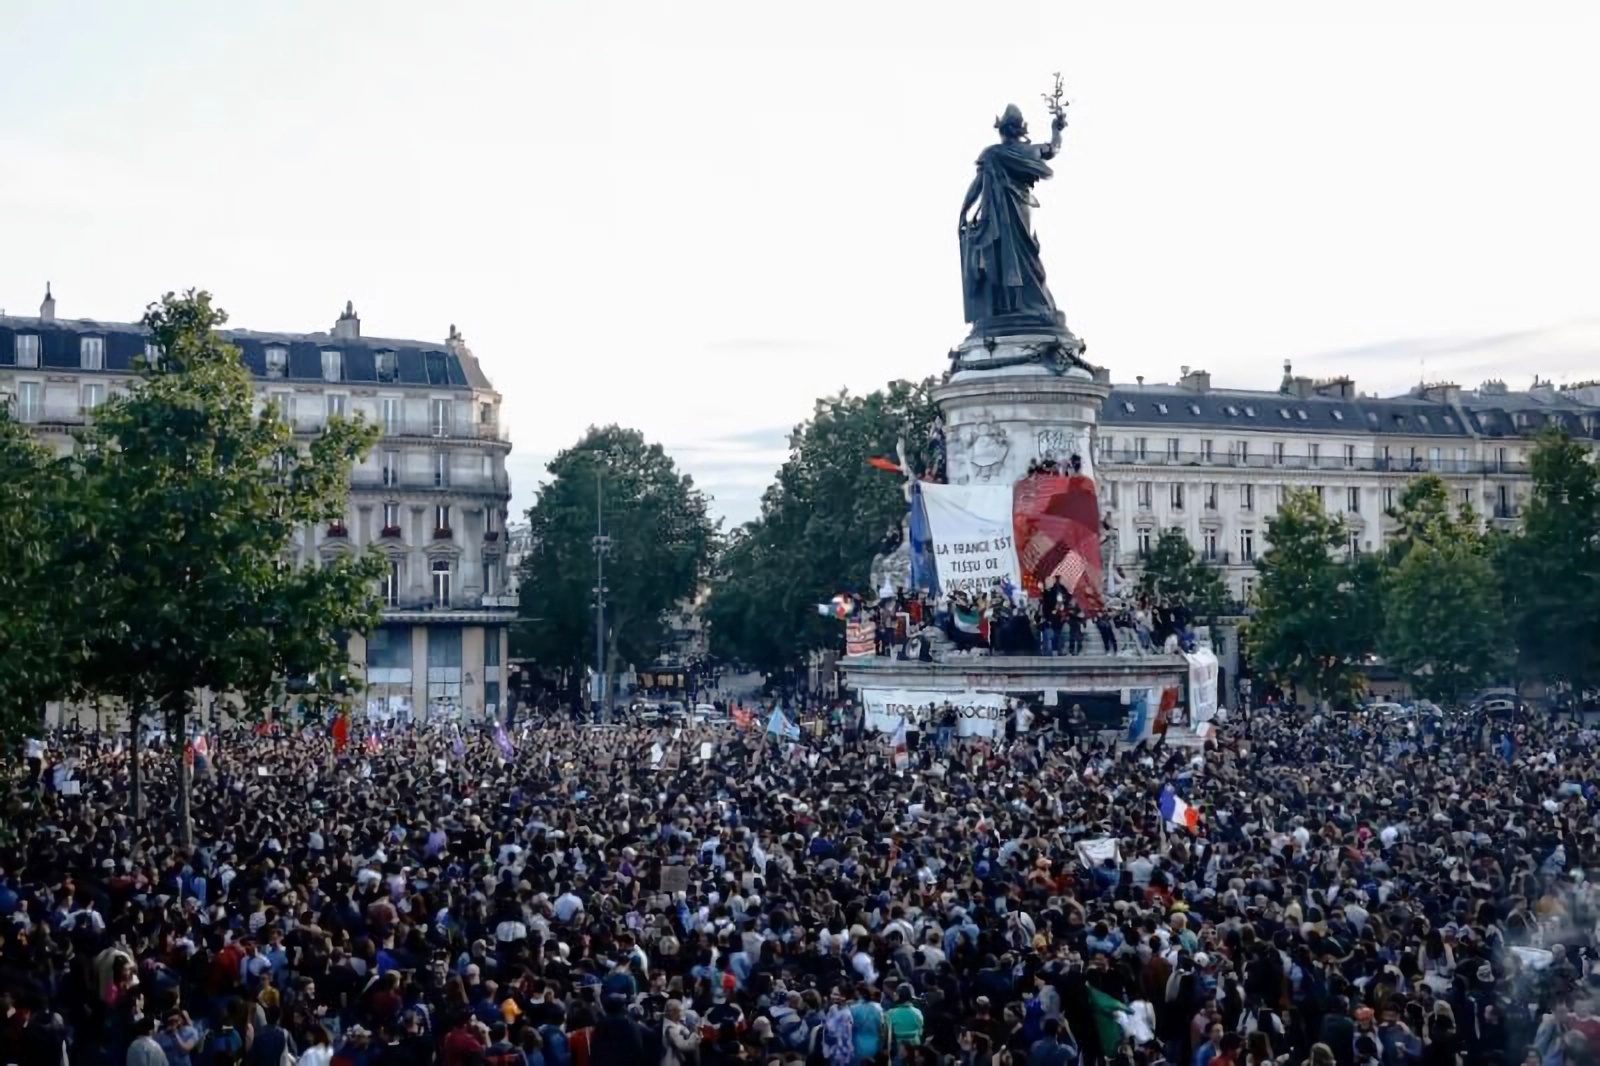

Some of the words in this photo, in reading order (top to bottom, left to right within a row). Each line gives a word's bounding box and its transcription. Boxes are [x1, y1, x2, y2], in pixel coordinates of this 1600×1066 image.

[936, 543, 949, 555] LA
[953, 540, 990, 554] FRANCE
[994, 536, 1012, 550] EST
[951, 560, 981, 573] TISSU
[985, 557, 999, 569] DE
[945, 572, 1010, 591] MIGRATI
